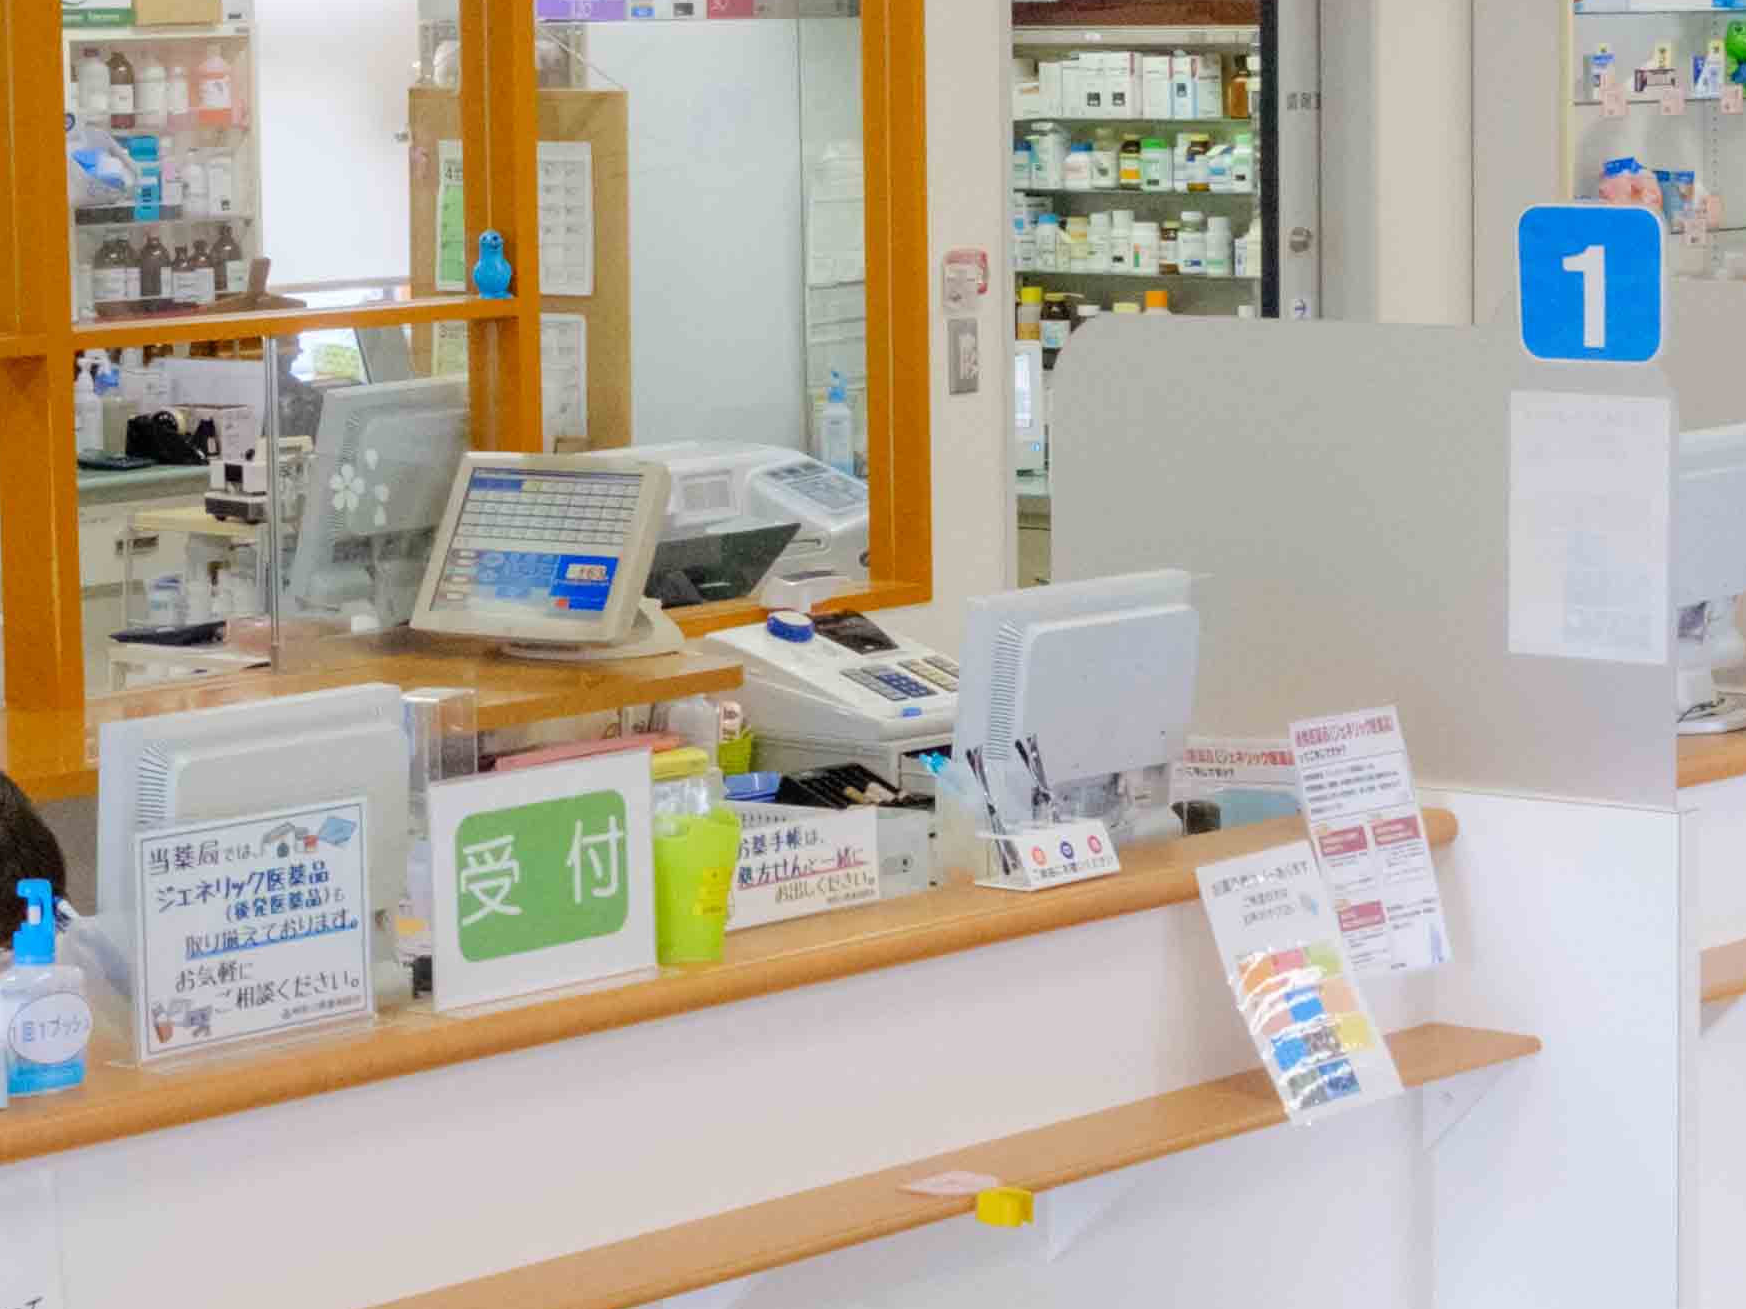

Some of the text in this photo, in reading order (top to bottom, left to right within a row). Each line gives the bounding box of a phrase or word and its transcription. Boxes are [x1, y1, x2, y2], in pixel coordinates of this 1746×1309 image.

[1562, 245, 1607, 348] 1
[157, 860, 330, 914] ジェネリック医薬品
[459, 814, 625, 929] 受付
[175, 961, 255, 994] お気軽に
[213, 970, 360, 1015] ご相談ください。
